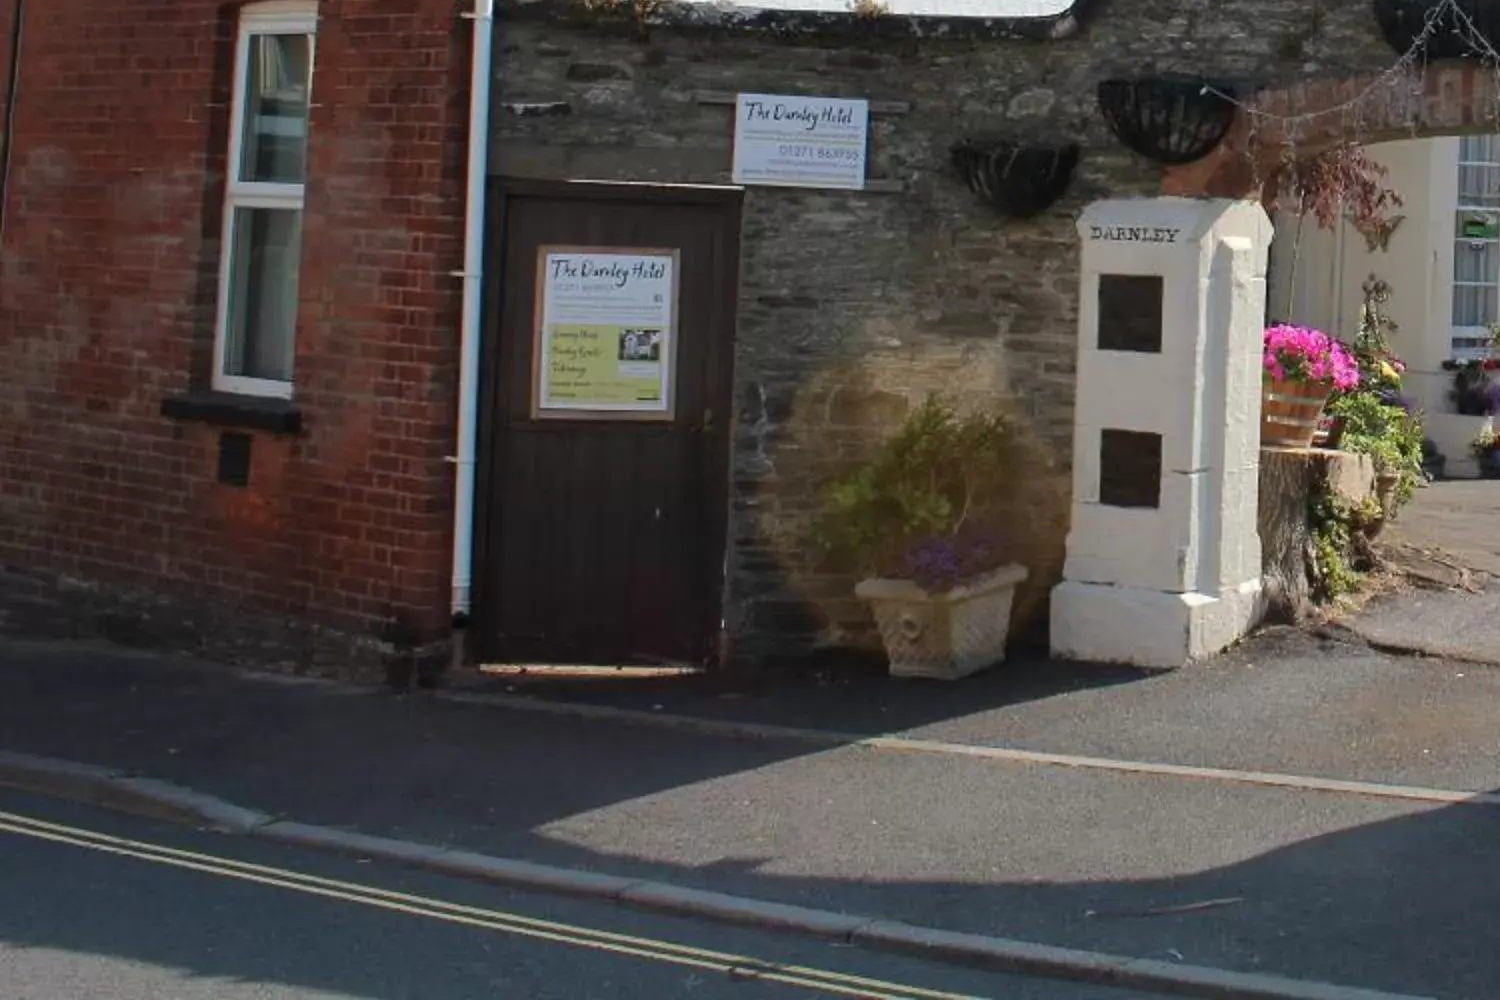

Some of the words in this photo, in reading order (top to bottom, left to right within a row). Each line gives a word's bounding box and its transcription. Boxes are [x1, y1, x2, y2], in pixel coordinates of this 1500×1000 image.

[744, 100, 769, 121] The
[774, 103, 819, 130] Darnley
[822, 105, 853, 123] Hotel
[779, 144, 814, 158] 01271
[1090, 226, 1180, 242] DARNLEY
[551, 259, 577, 281] The
[581, 259, 629, 287] Darnley
[631, 261, 665, 280] Hotel
